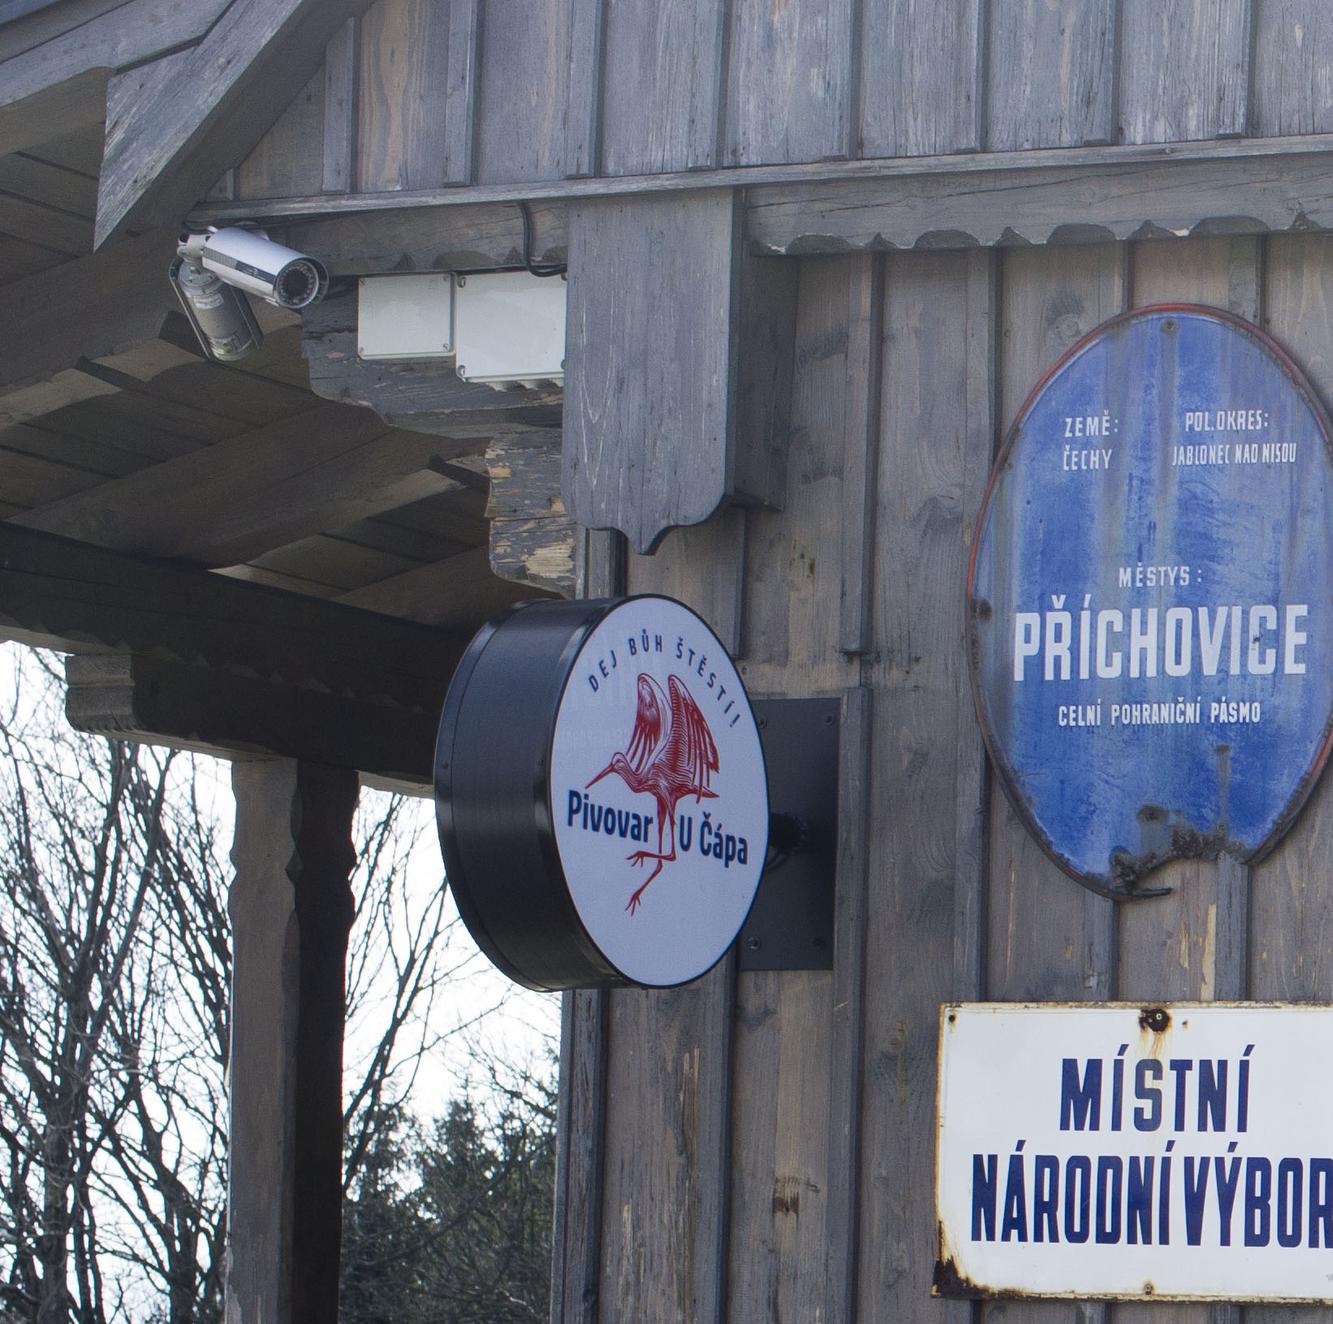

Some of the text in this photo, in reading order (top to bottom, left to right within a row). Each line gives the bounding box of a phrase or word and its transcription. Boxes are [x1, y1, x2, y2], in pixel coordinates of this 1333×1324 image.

[1063, 445, 1112, 471] ČECHY
[1064, 409, 1118, 437] ZEMĚ:
[1172, 442, 1297, 466] JABLONEC NAD NISOU
[1013, 593, 1308, 682] PŘÍCHOVICE
[588, 629, 740, 727] DEJ BŮH ŠTĚSTÍ!
[1058, 696, 1261, 727] CELNÍ POHRANIČNÍ PÁSMO
[567, 789, 748, 868] Pivovar U Čápa
[1059, 1043, 1255, 1133] MÍSTNÍ
[970, 1139, 1176, 1246] NÁRODNÍ
